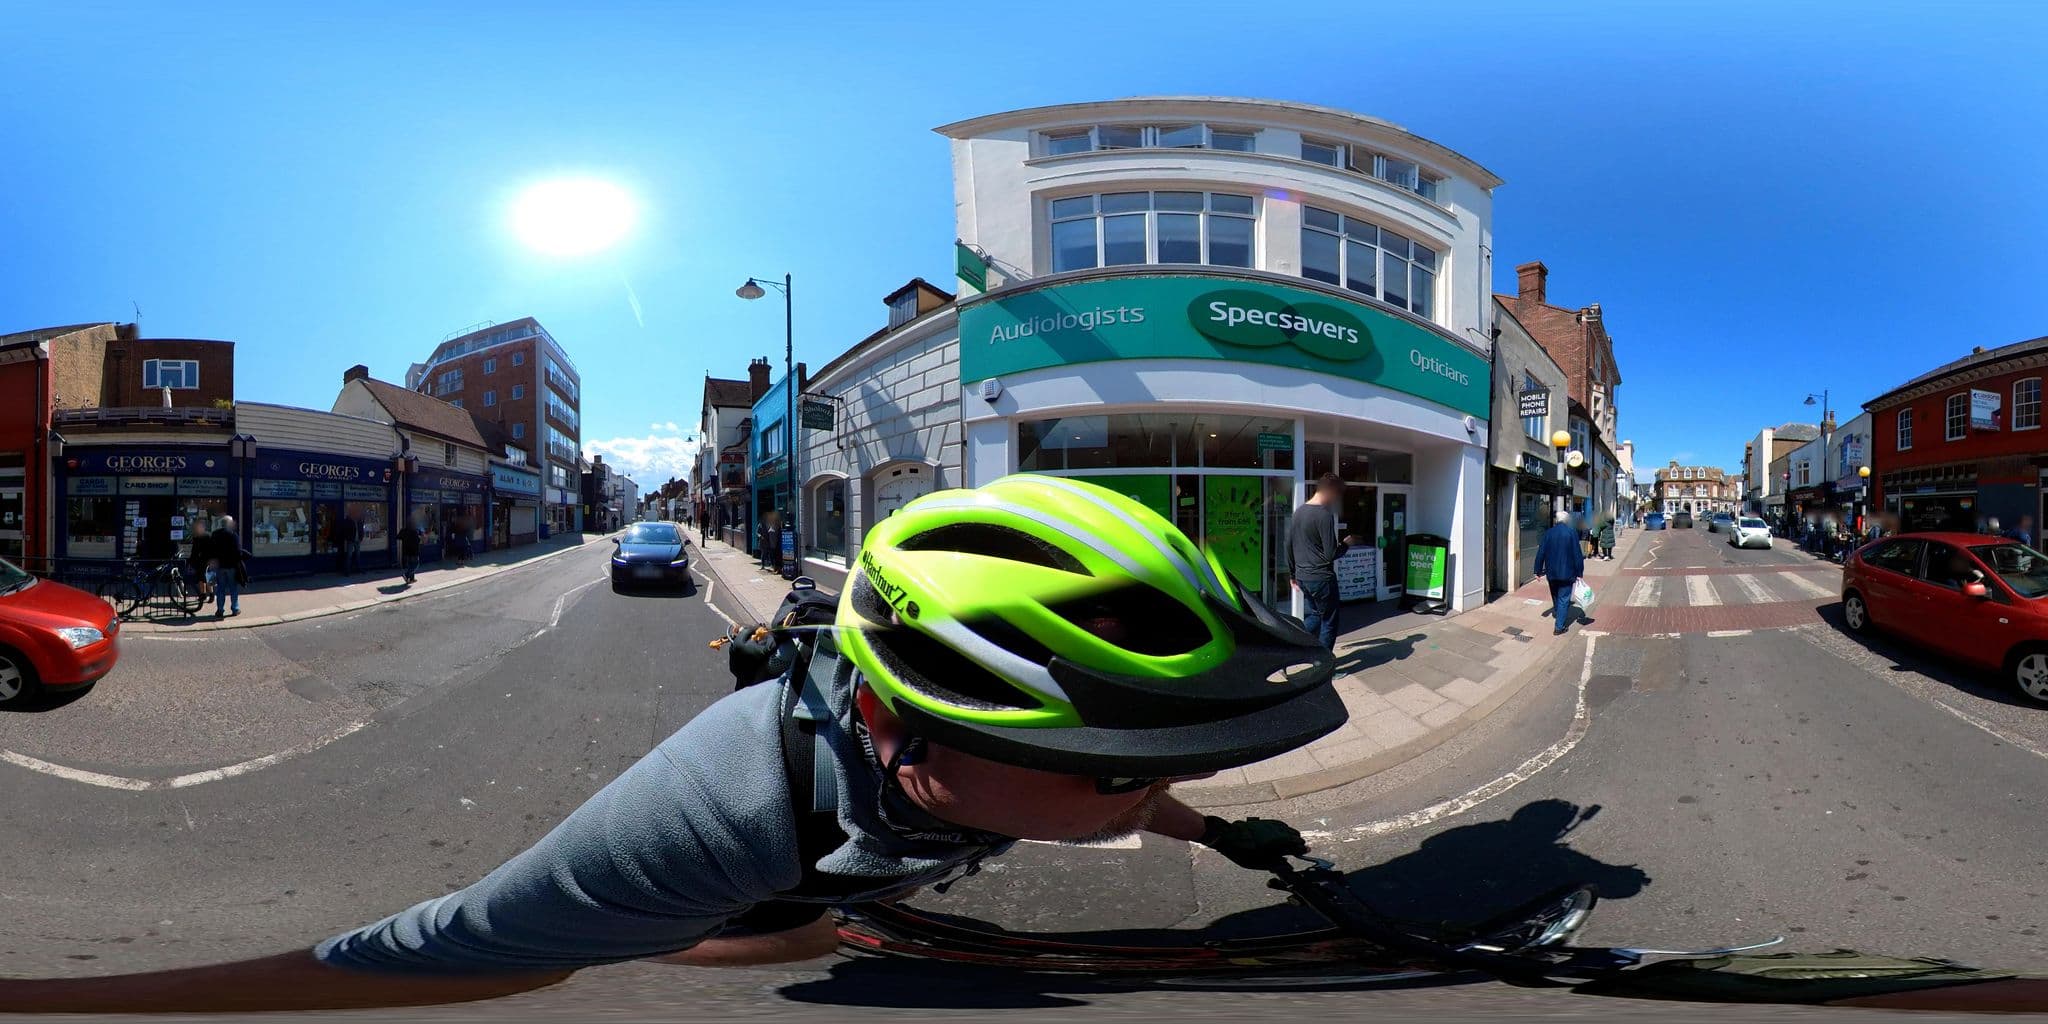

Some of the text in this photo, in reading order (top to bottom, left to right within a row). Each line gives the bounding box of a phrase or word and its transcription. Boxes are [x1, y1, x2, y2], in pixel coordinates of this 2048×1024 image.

[990, 306, 1145, 344] Audiologists
[1209, 301, 1359, 344] Specsavers
[1410, 349, 1469, 386] Opticians
[1520, 392, 1546, 402] MOBILE
[1521, 400, 1545, 409] PHONE
[1520, 408, 1546, 416] REPAIRS
